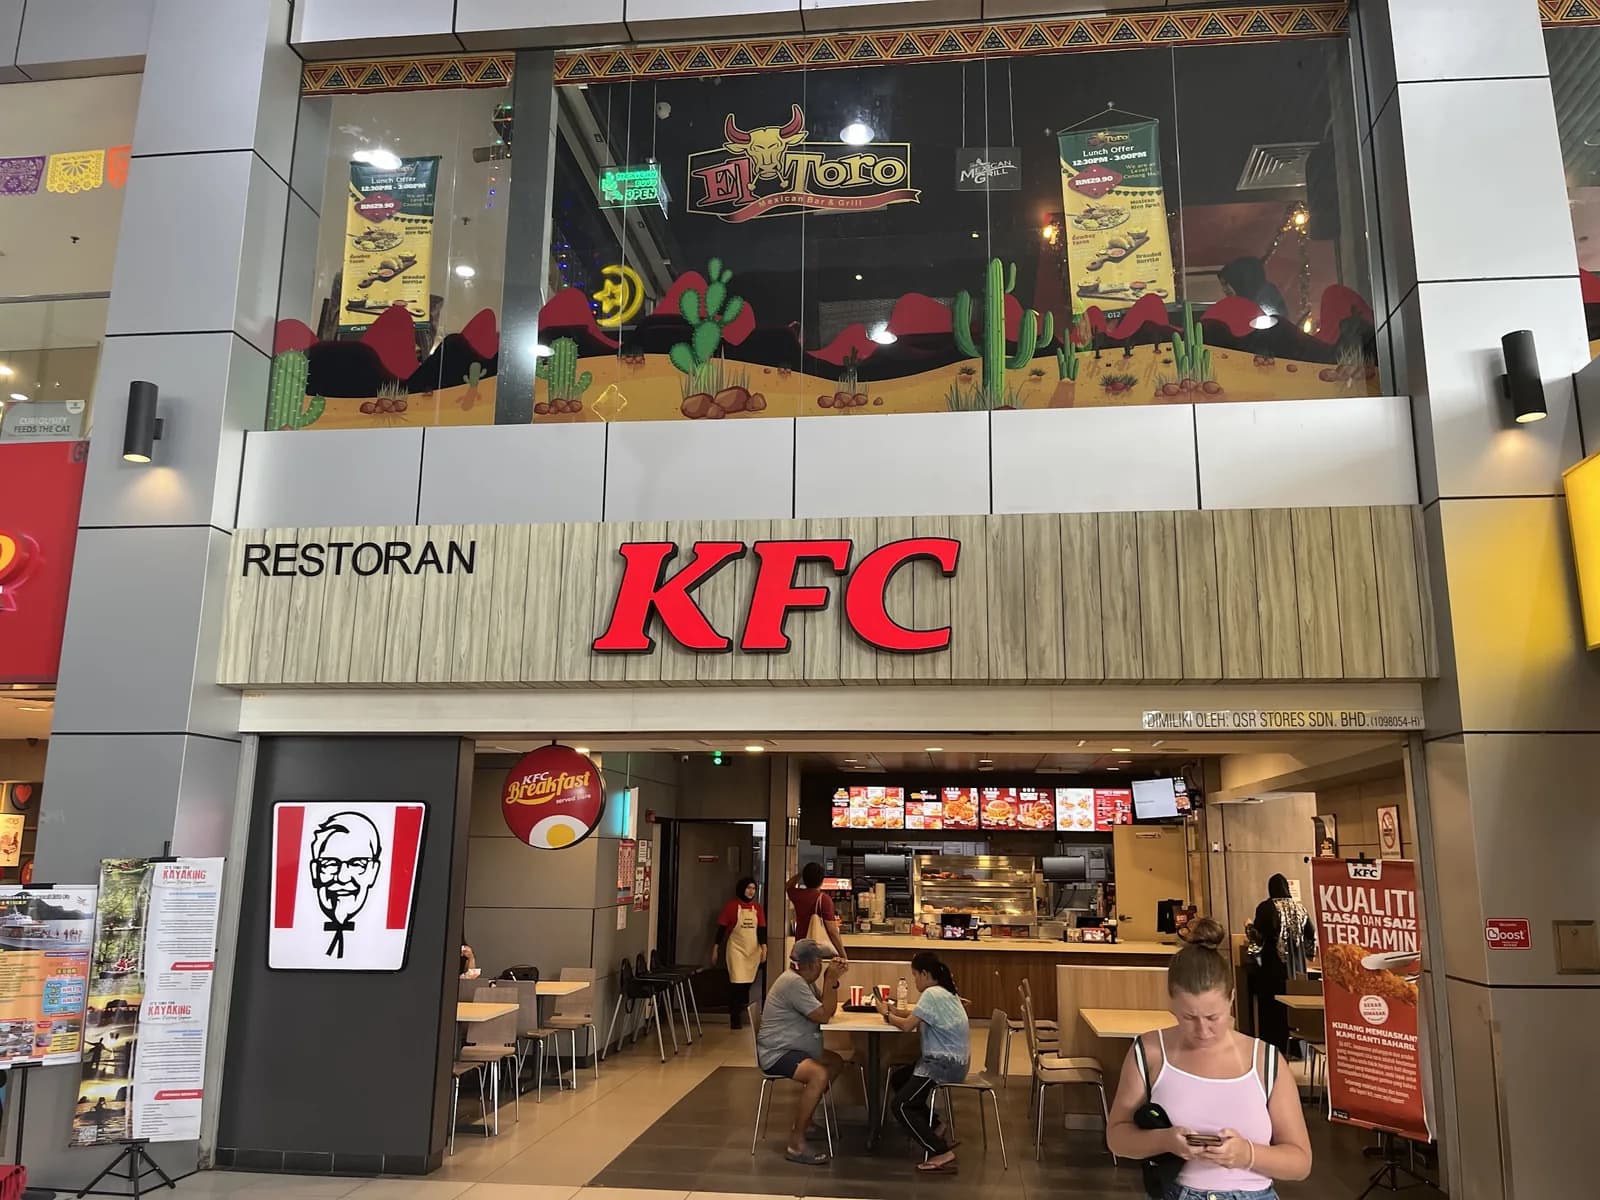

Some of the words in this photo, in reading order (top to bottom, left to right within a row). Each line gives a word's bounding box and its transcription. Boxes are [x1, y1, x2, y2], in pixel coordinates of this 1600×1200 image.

[1083, 148, 1108, 157] Lunch
[1111, 145, 1135, 153] Offer
[371, 176, 394, 184] Lunch
[692, 157, 761, 207] El
[783, 152, 907, 194] Toro
[626, 188, 658, 200] OPEN
[758, 195, 804, 208] Mexican
[807, 196, 825, 205] Bar
[14, 425, 37, 433] FEEDS
[39, 425, 54, 433] THE
[55, 425, 71, 433] CAT
[242, 541, 476, 577] RESTORAN
[592, 537, 961, 654] KFC
[1147, 712, 1193, 728] DIMILIKI
[1195, 712, 1229, 728] OLEH:
[1233, 712, 1257, 728] QSR
[1260, 712, 1306, 728] STORES
[1308, 711, 1338, 727] SDN.
[523, 771, 550, 784] KFC
[506, 771, 591, 805] Breakfast
[163, 869, 206, 880] KAYAKING
[1353, 869, 1378, 878] KFC
[1320, 885, 1415, 918] KUALITI
[1322, 912, 1361, 925] RASA
[1362, 915, 1382, 927] DAN
[1383, 917, 1416, 930] SAIZ
[1323, 924, 1417, 952] TERJAMIN
[148, 1005, 191, 1016] KAYAKING
[1332, 1021, 1364, 1033] KURANG
[1336, 1030, 1356, 1040] KAMI
[1357, 1035, 1381, 1045] GANTI
